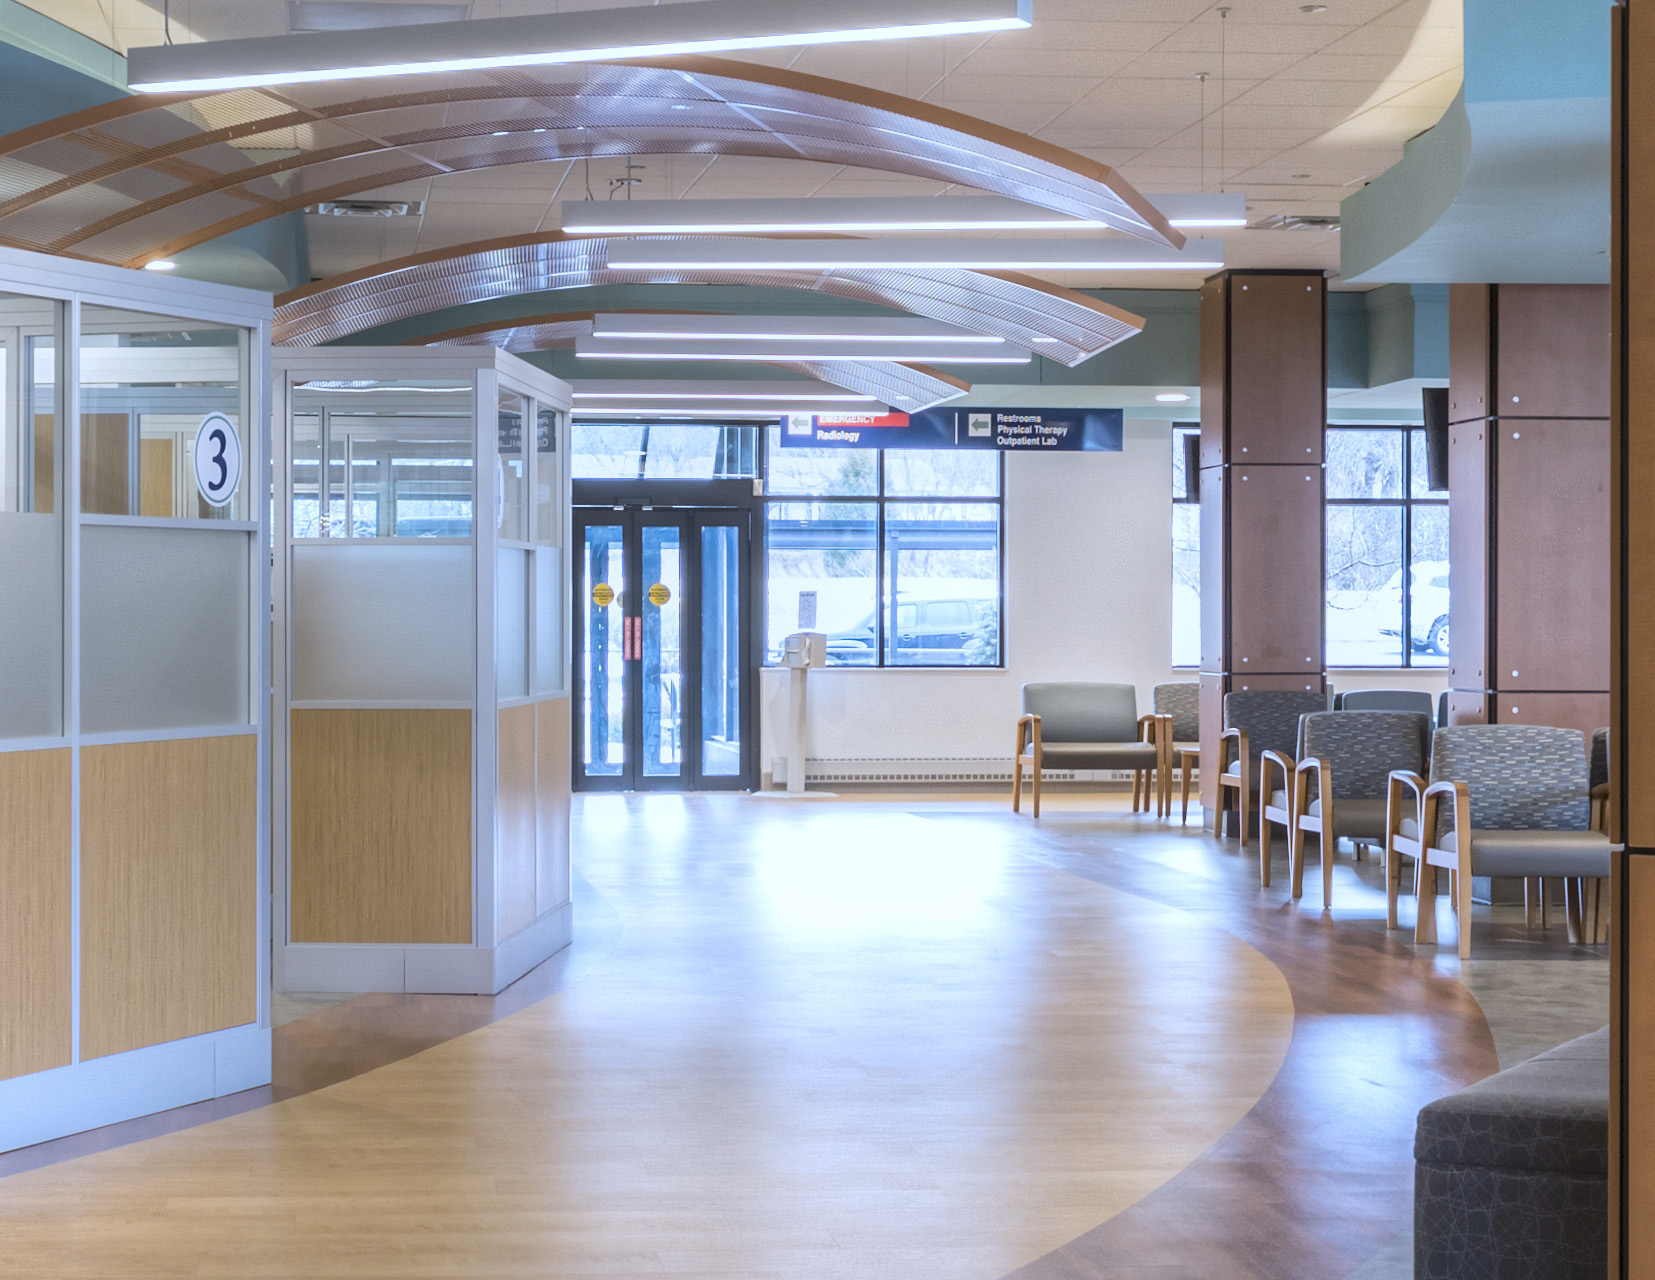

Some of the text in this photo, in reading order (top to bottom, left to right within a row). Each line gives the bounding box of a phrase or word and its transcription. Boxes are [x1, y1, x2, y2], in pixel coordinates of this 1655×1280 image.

[996, 413, 1042, 423] Restrooms
[816, 430, 860, 442] Radiology
[997, 424, 1068, 436] Physical Therapy
[996, 436, 1057, 447] Outpatient Lab
[207, 428, 228, 491] 3
